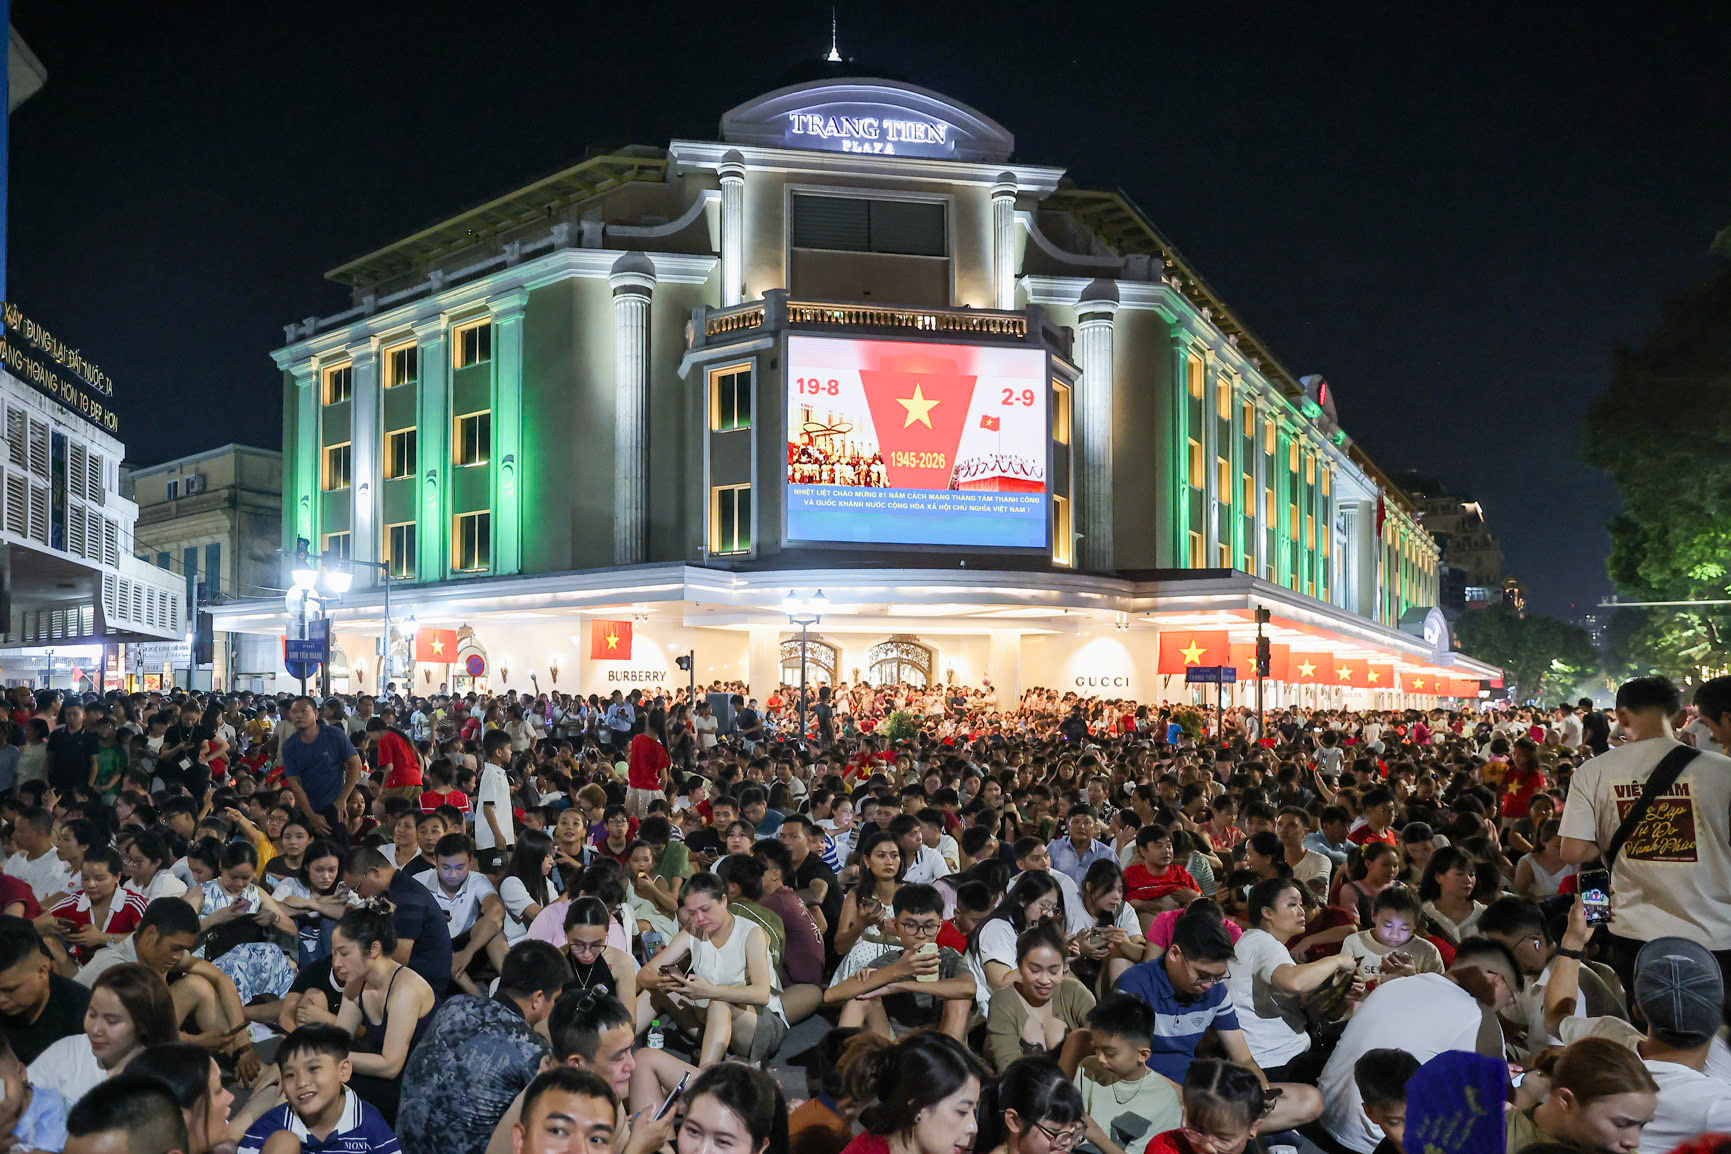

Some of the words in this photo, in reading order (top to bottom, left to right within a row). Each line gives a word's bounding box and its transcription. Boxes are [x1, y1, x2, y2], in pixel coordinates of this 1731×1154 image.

[789, 113, 879, 138] TRANG
[882, 119, 948, 144] TIEN
[842, 140, 896, 155] PLAZA
[106, 377, 113, 396] TA
[796, 378, 839, 396] 19-8
[1001, 388, 1035, 406] 2-9
[891, 451, 946, 469] 1945-2026
[608, 670, 667, 682] BURBERRY
[1075, 676, 1130, 687] GUCCI
